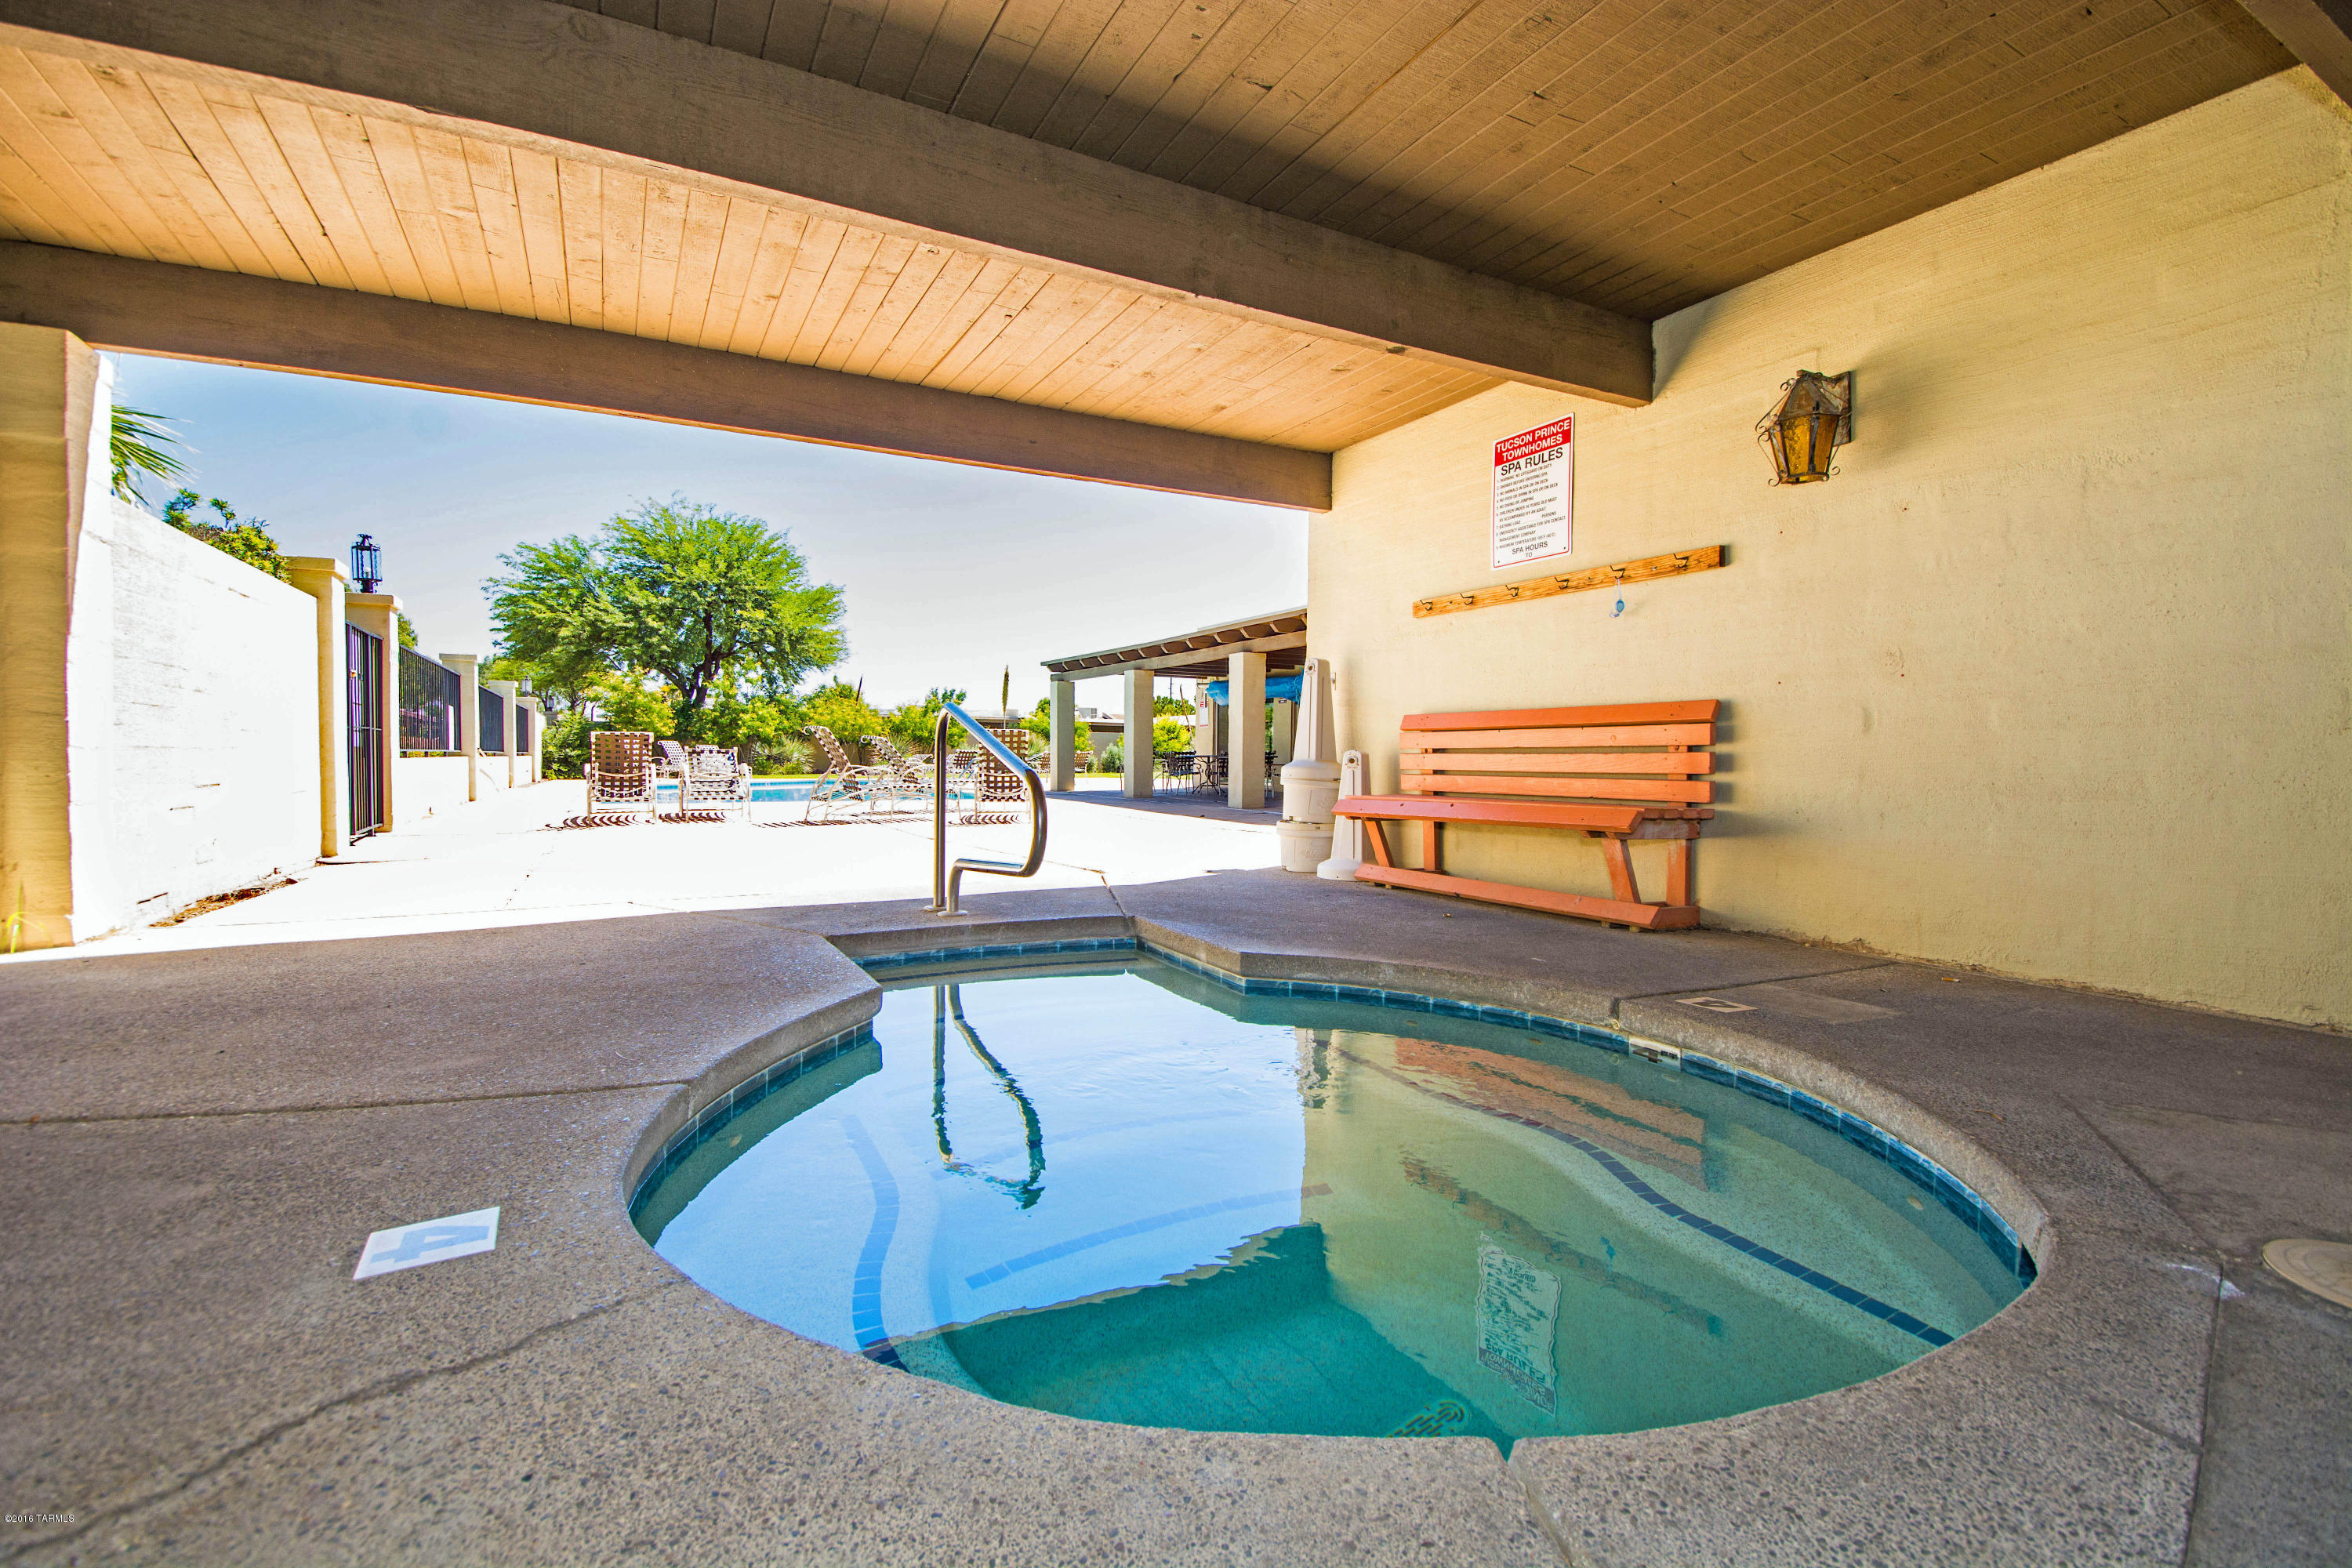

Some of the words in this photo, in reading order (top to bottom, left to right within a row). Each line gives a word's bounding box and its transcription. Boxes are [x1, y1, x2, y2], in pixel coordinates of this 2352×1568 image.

[1496, 432, 1533, 453] TUCSON
[1535, 419, 1570, 440] PRINCE
[1502, 434, 1563, 462] TOWNHOMES
[1501, 460, 1522, 476] SPA
[1525, 447, 1563, 469] RULES
[1512, 546, 1523, 555] SPA
[1525, 541, 1548, 552] HOURS
[1632, 1046, 1663, 1064] 4
[369, 1225, 490, 1265] 4
